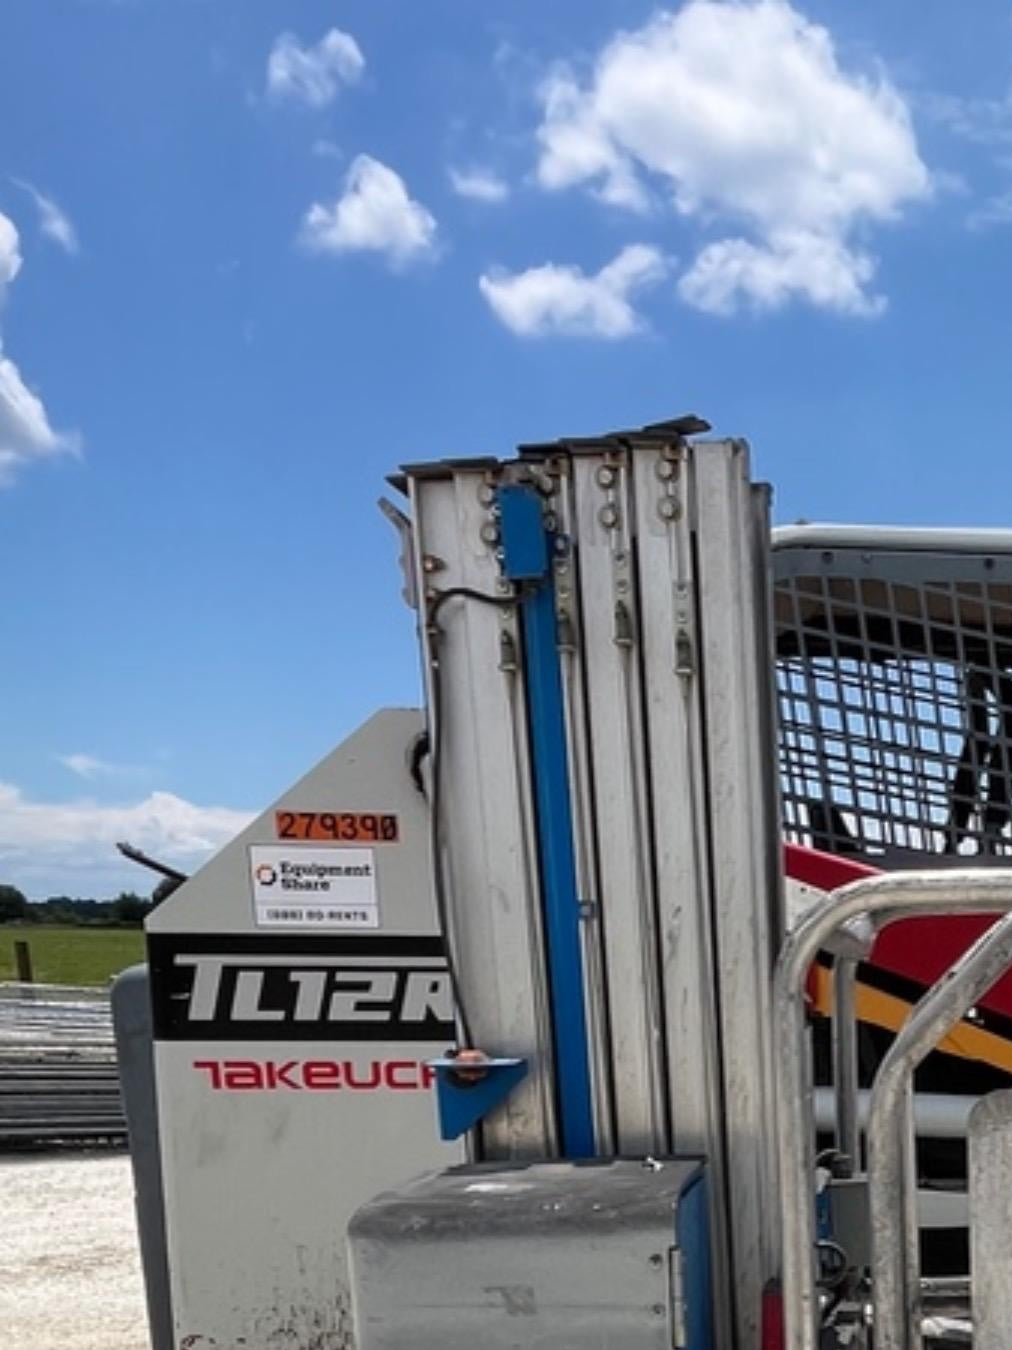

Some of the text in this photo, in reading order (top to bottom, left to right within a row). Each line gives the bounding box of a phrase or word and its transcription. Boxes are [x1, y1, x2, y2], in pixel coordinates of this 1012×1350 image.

[278, 812, 397, 840] 279390
[281, 862, 371, 878] Equipment
[281, 879, 330, 891] Share
[173, 953, 455, 1021] TL12R
